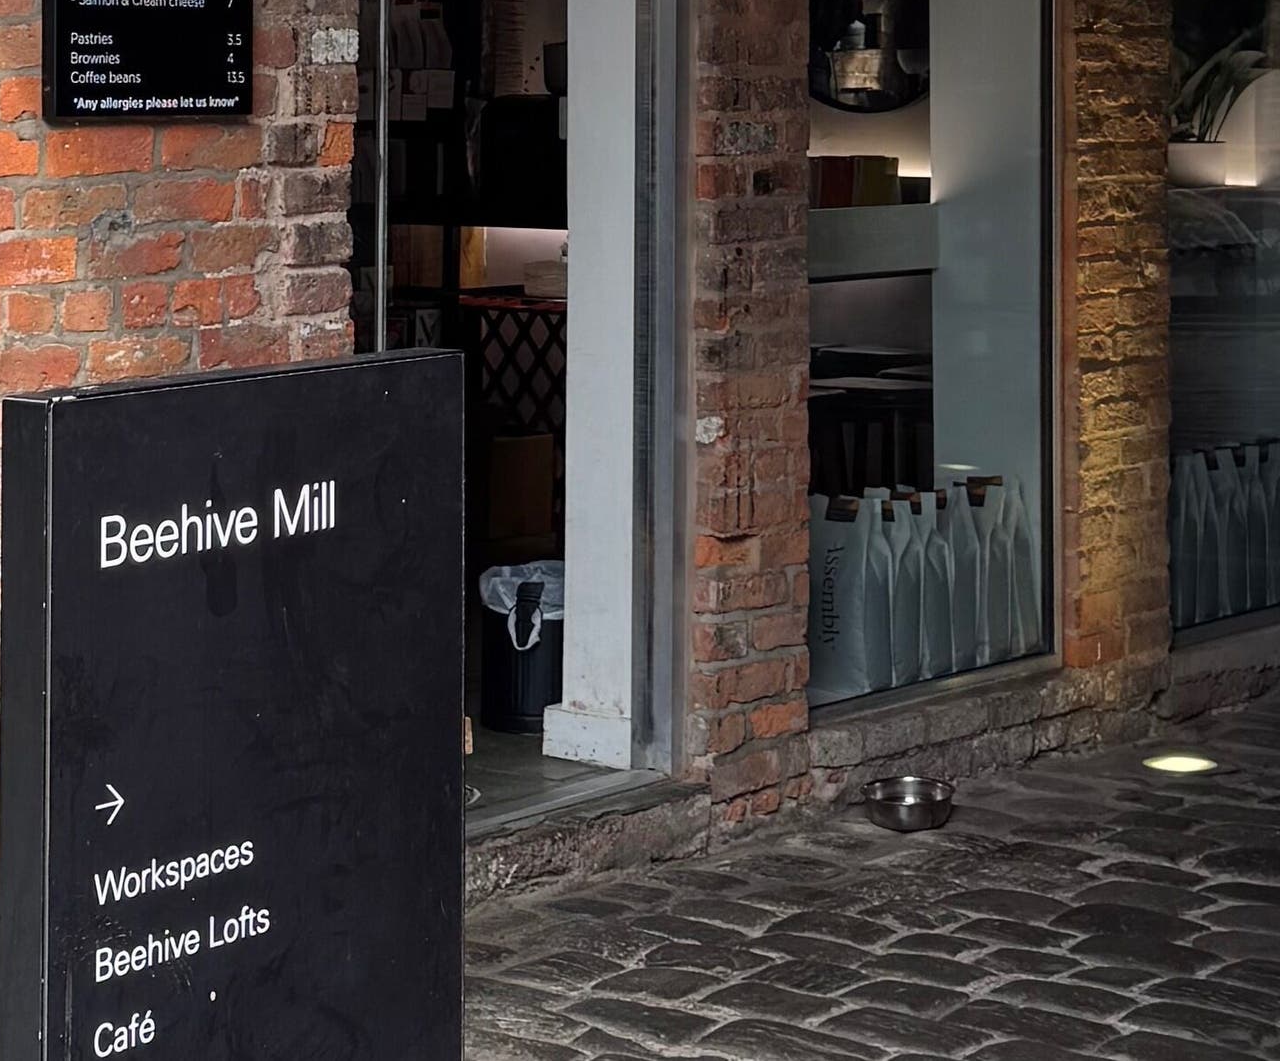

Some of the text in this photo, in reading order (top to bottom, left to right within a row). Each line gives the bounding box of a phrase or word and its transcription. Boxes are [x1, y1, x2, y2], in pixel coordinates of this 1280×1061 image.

[70, 31, 114, 45] Pastries
[70, 51, 234, 65] Brownies 4
[70, 70, 107, 84] Coffee
[108, 70, 142, 84] beans
[99, 96, 144, 111] allergies
[145, 96, 179, 111] please
[179, 95, 194, 108] let
[195, 98, 208, 108] us
[100, 479, 336, 569] Beehive Mill
[93, 839, 254, 906] Workspaces
[95, 905, 271, 983] Beehive Lofts
[93, 1009, 156, 1059] Café
